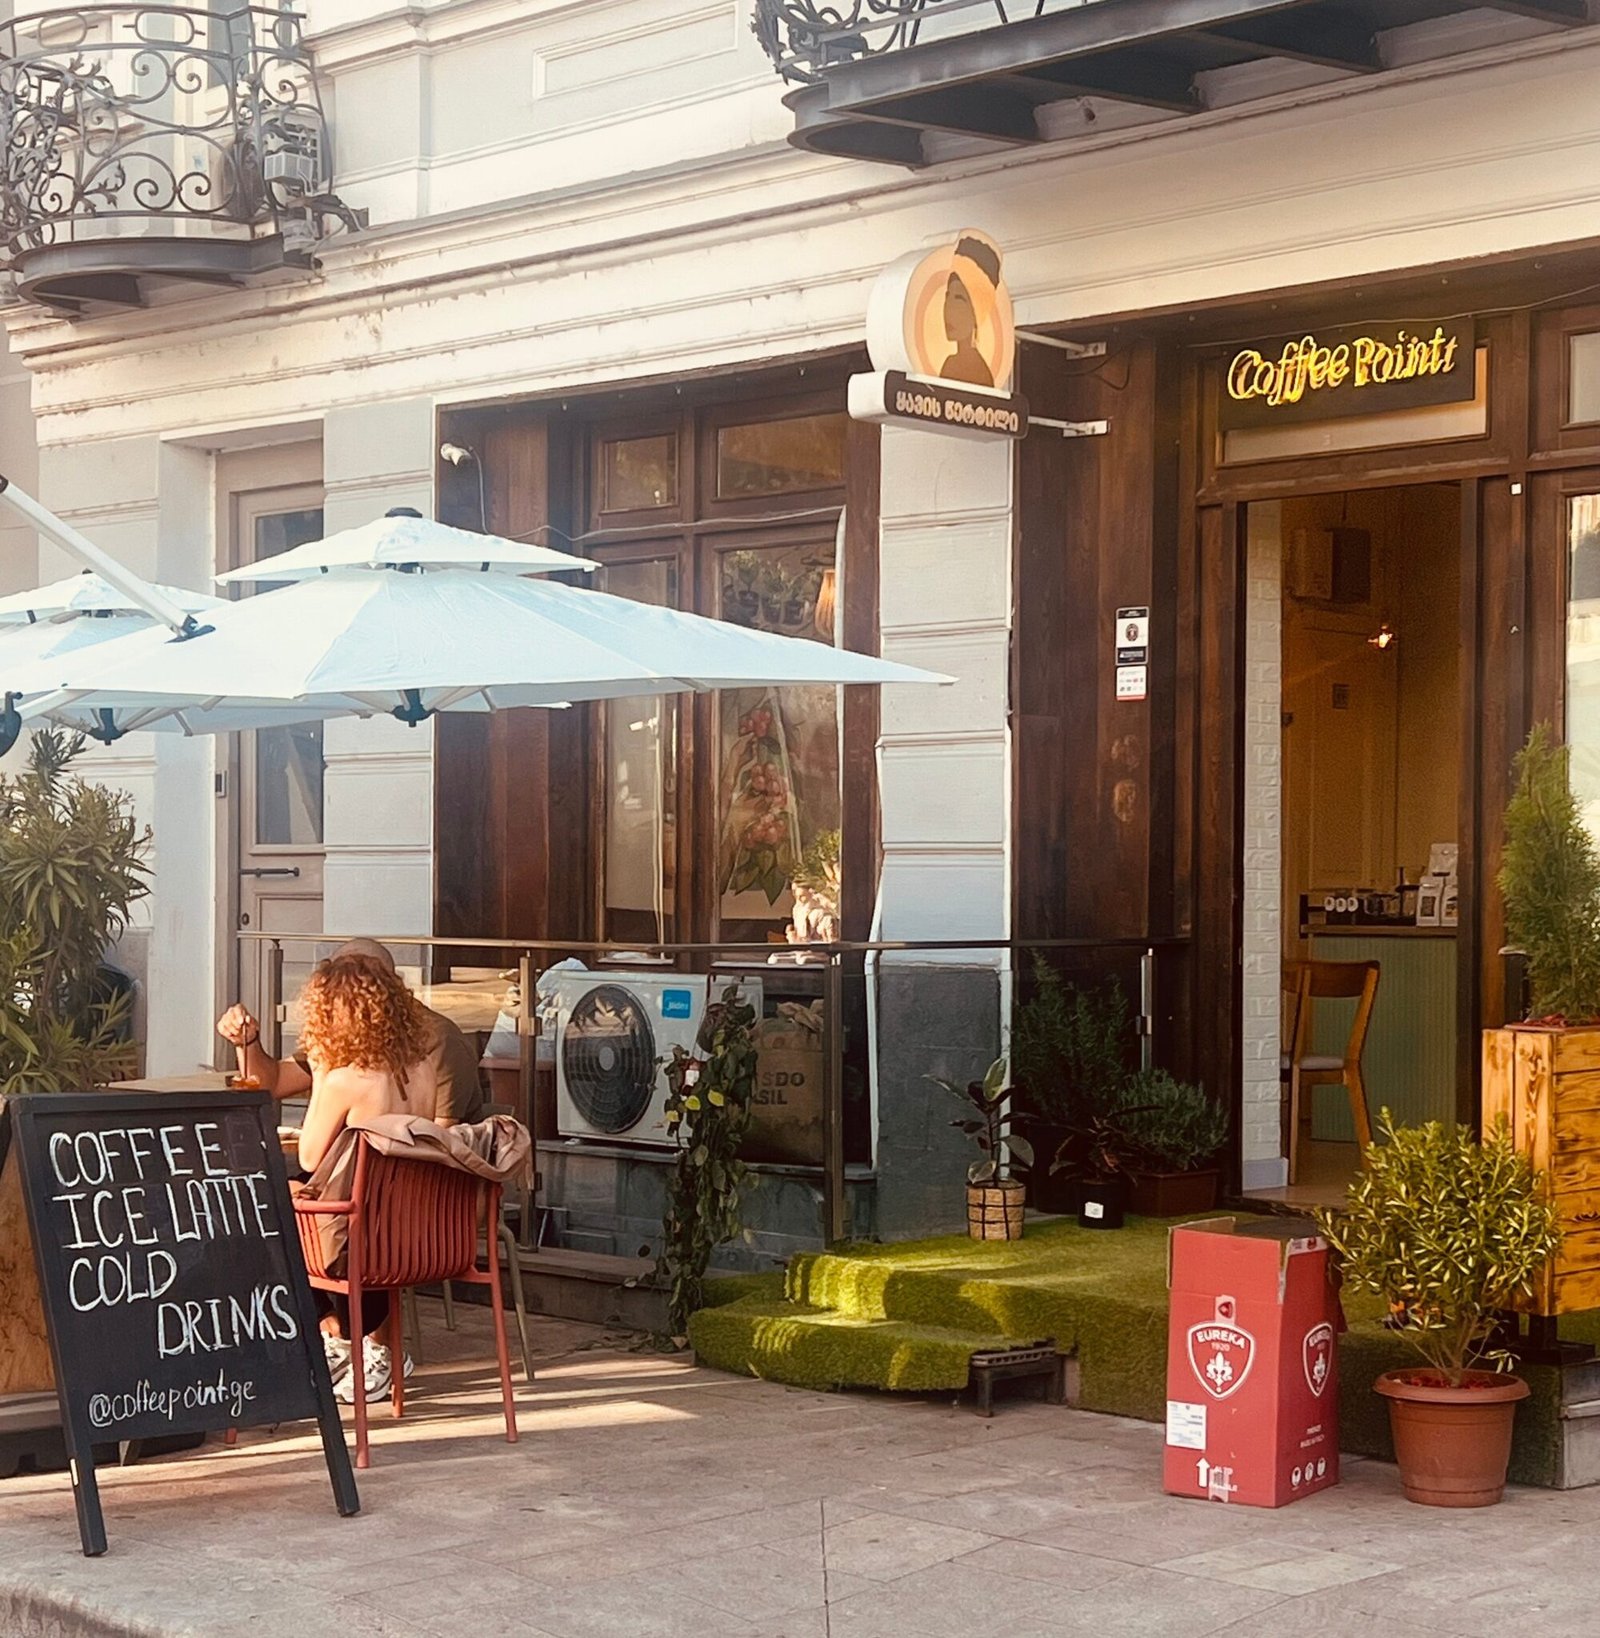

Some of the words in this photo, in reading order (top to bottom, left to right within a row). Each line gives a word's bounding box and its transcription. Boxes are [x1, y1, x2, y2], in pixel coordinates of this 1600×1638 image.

[1227, 335, 1351, 407] Coffee
[1352, 327, 1452, 387] Point
[896, 391, 941, 418] ყავის
[944, 400, 1019, 432] წერტილი
[48, 1122, 228, 1188] COFFEE
[51, 1187, 160, 1250] ICE
[166, 1171, 281, 1242] LATTE
[69, 1249, 178, 1313] COLD
[157, 1284, 299, 1360] DRINKS
[1196, 1329, 1246, 1350] EUREKA
